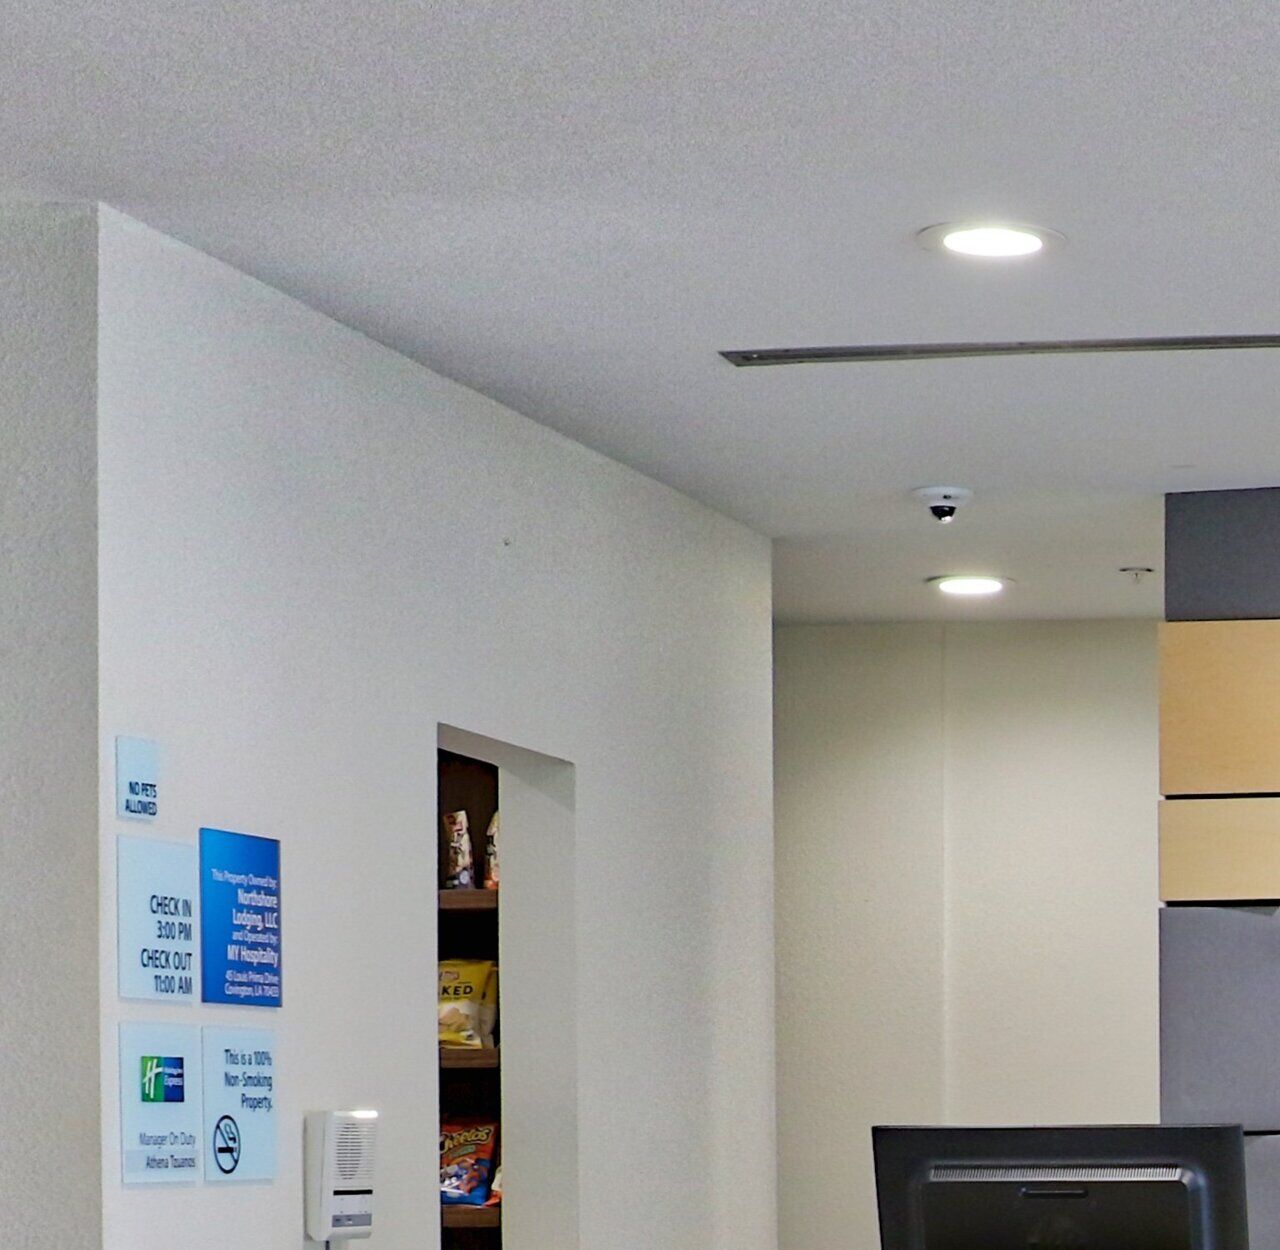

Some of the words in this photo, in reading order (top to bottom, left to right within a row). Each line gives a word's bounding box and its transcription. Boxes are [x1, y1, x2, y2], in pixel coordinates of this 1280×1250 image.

[129, 781, 140, 796] NO
[141, 782, 157, 798] PETS
[125, 799, 157, 816] ALLOWED
[150, 894, 180, 917] CHECK
[182, 898, 192, 917] IN
[237, 888, 278, 908] Northshore
[232, 908, 263, 931] Lodging,
[264, 911, 278, 929] LLC
[157, 920, 176, 939] 3:00
[178, 921, 192, 941] PM
[141, 948, 171, 969] CHECK
[173, 951, 192, 970] OUT
[227, 945, 239, 961] MY
[240, 945, 279, 968] Hospitality
[154, 975, 176, 993] 11:00
[178, 976, 192, 994] AM
[224, 1048, 239, 1065] This
[240, 1051, 246, 1066] is
[247, 1053, 253, 1066] a
[253, 1050, 272, 1067] 100%
[224, 1071, 273, 1092] Non-Smoking
[139, 1132, 168, 1149] Manager
[169, 1132, 179, 1146] On
[180, 1132, 197, 1149] Duty
